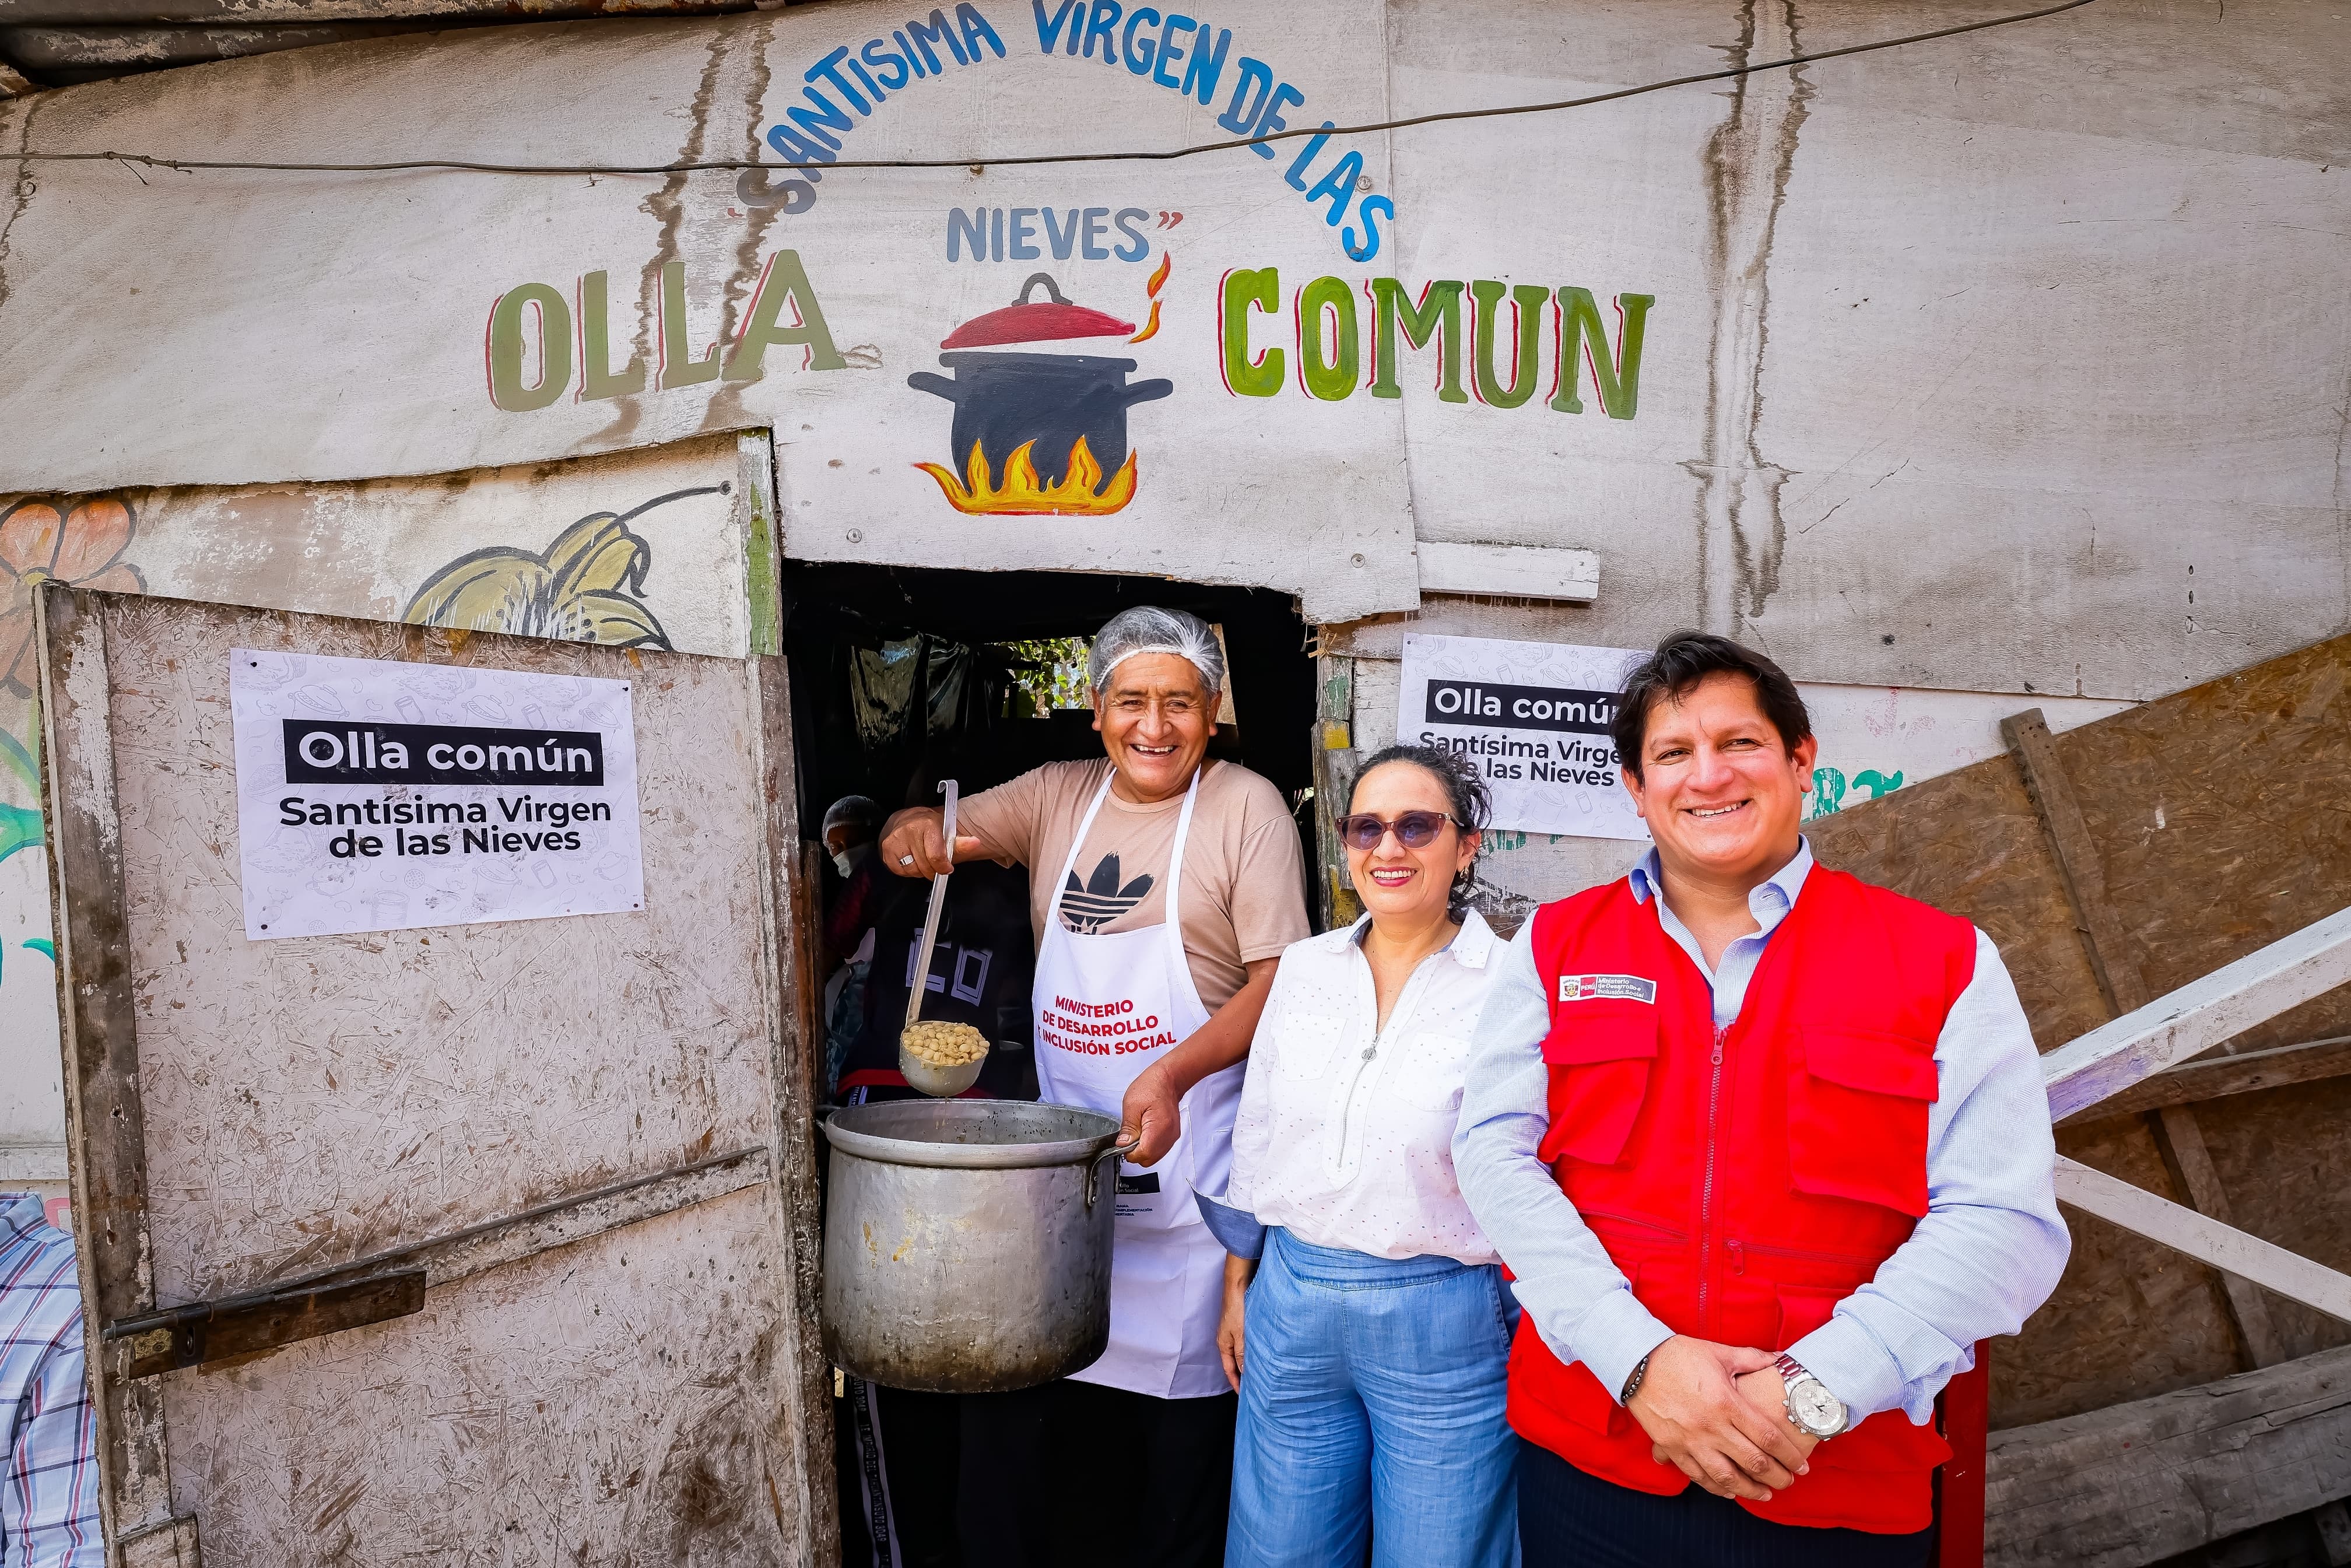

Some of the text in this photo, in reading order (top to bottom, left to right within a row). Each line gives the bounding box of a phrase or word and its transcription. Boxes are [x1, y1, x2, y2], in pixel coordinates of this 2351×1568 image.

[736, 0, 1395, 262] SANTISIMA VIRGEN DE LAS
[486, 250, 1656, 421] OLLA COMUN
[1434, 687, 1502, 717] Olla
[299, 731, 593, 773] Olla común
[1419, 731, 1622, 769] Santísima Virge
[1486, 757, 1522, 780] las
[1530, 761, 1615, 787] Nieves
[279, 794, 612, 829] Santísima Virgen
[329, 824, 581, 858] de las Nieves
[1055, 995, 1134, 1018] MINISTERIO
[1625, 990, 1644, 998] Social
[1043, 1009, 1159, 1037] DE DESARROLLO
[1043, 1028, 1110, 1055] INCLUSIÓN
[1114, 1031, 1177, 1054] SOCIAL
